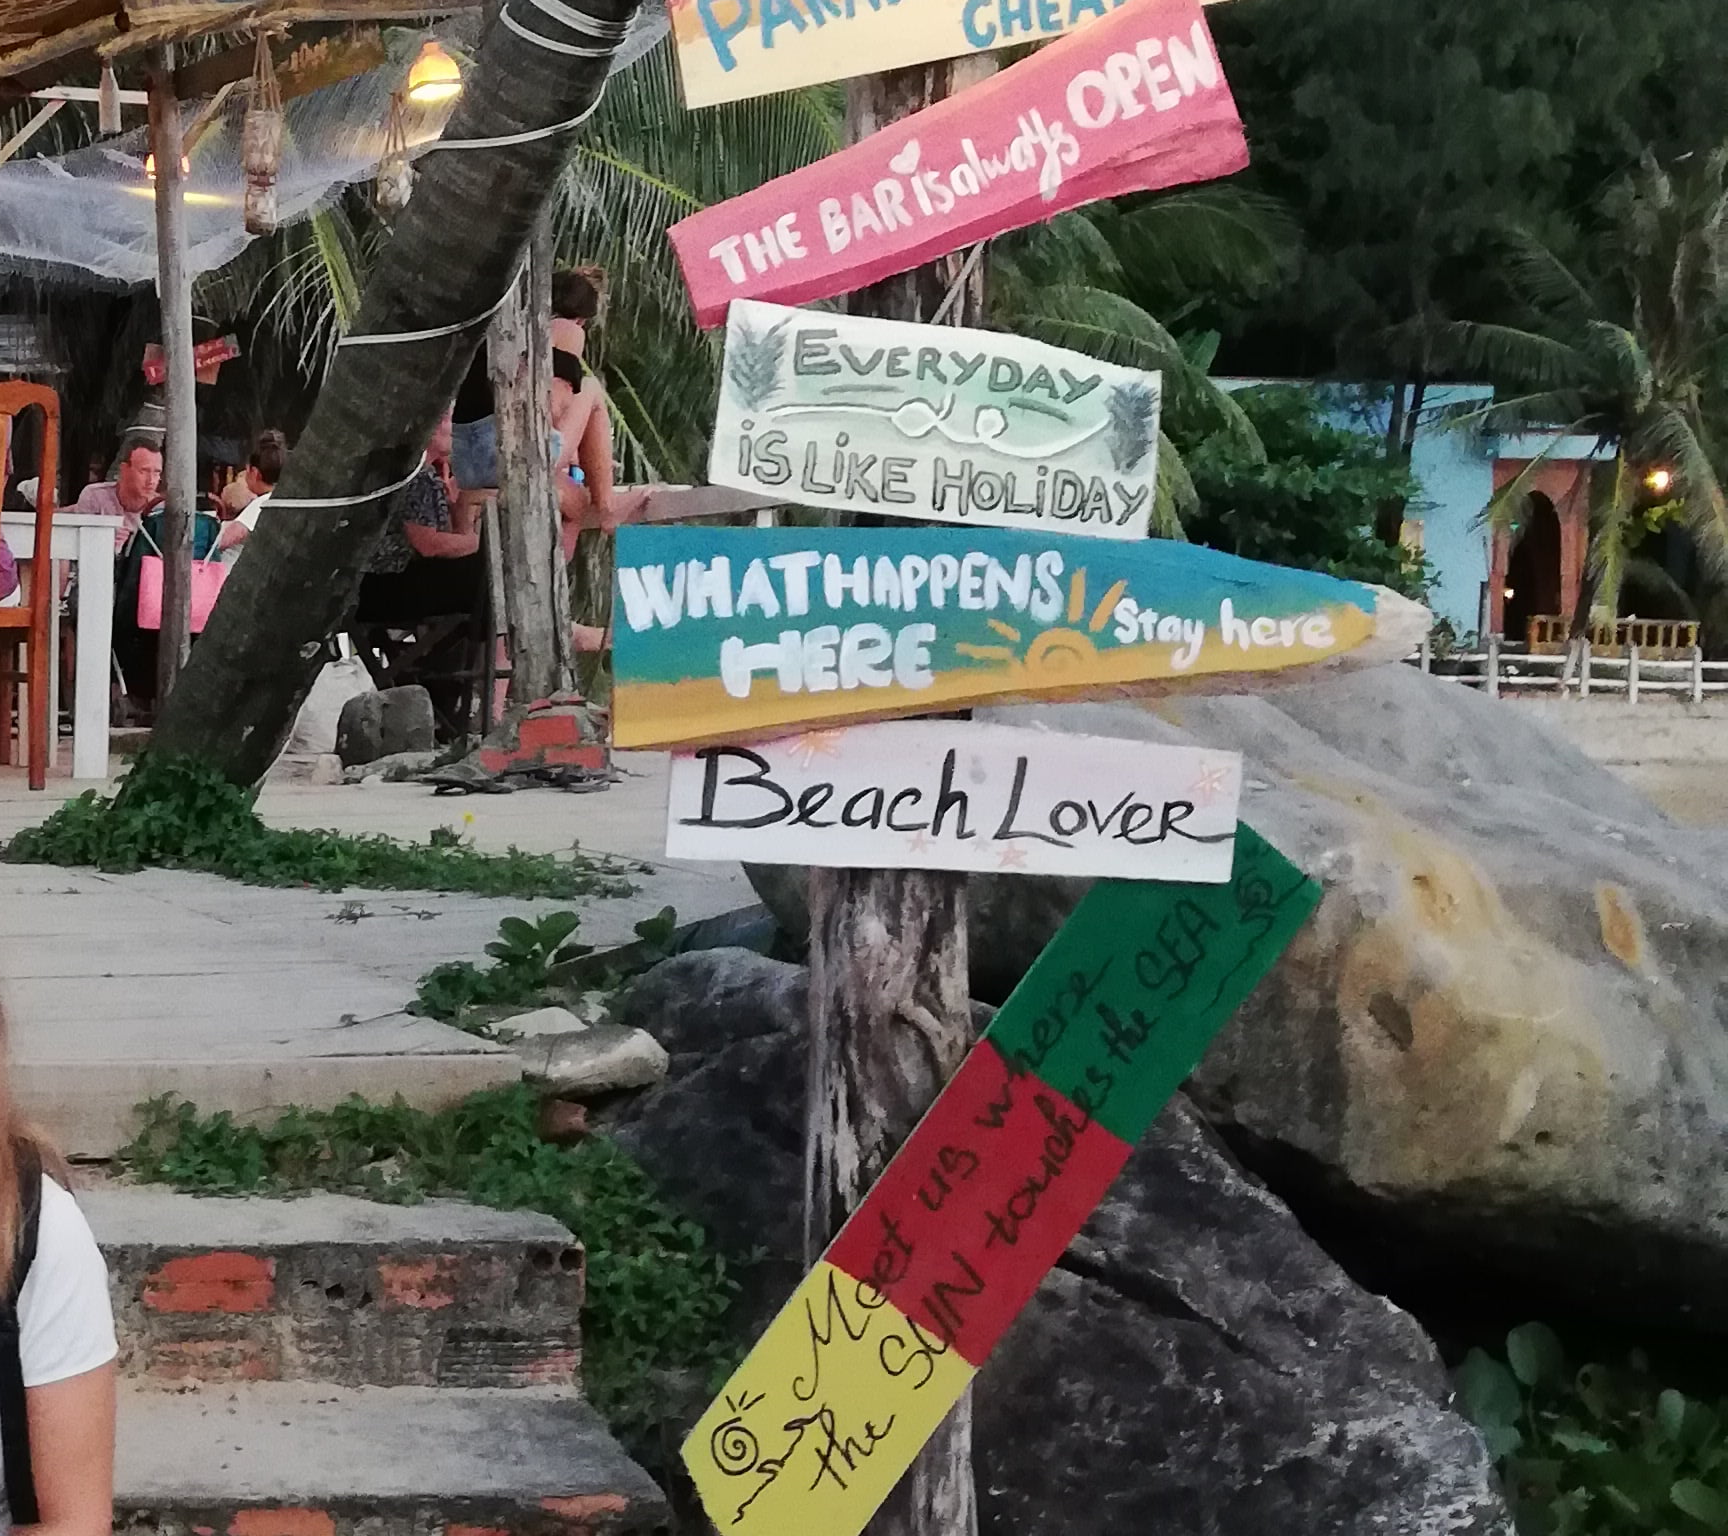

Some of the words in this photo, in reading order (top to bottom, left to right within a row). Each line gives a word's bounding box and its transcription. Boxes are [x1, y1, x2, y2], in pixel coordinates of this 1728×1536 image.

[708, 212, 808, 285] THE
[819, 178, 912, 256] BAR
[1066, 20, 1221, 131] OPEN
[793, 328, 1101, 405] EVERYDAY
[617, 551, 819, 632] WHAT
[821, 549, 1066, 623] HAPPENS
[1112, 599, 1204, 670] Stay
[1219, 599, 1336, 649] here
[721, 623, 937, 698] HERE
[678, 745, 975, 840] Beach
[792, 1211, 913, 1402] Meet
[917, 1146, 981, 1210] us
[974, 955, 1114, 1130] where
[810, 1412, 895, 1494] the
[880, 1254, 987, 1390] SUN
[986, 1066, 1112, 1251] touches
[1100, 1003, 1160, 1064] the
[1134, 899, 1221, 1002] SEA
